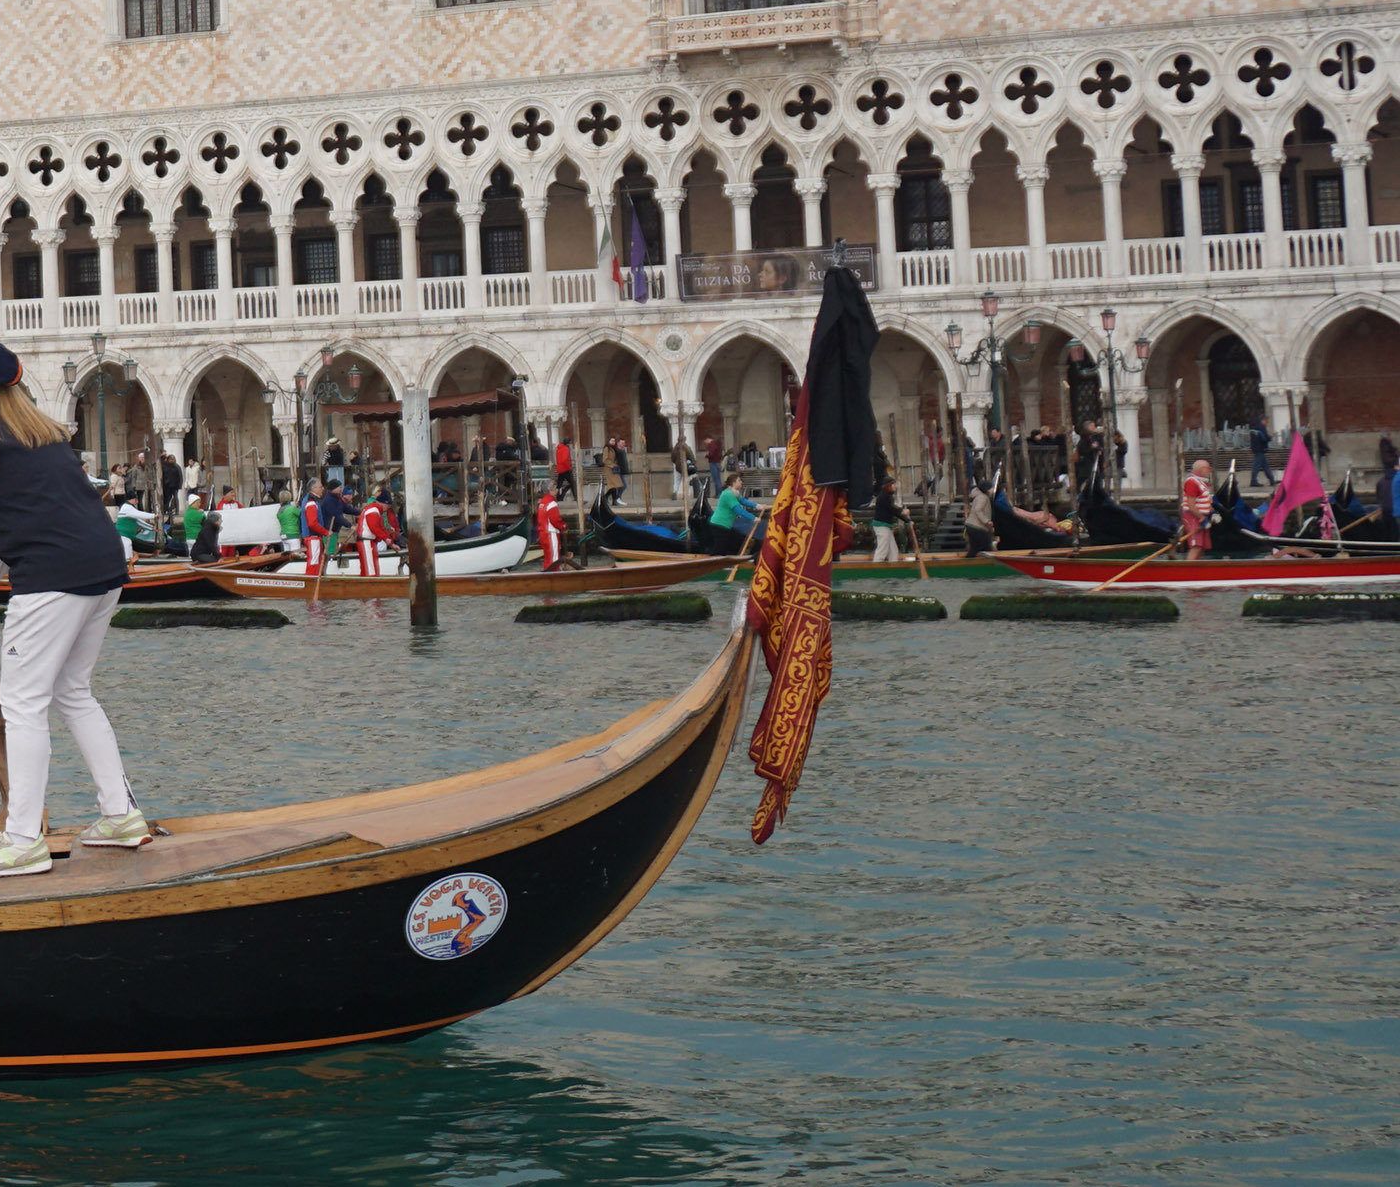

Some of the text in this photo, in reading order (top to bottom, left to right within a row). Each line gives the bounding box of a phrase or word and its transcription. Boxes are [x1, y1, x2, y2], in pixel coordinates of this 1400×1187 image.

[733, 265, 751, 274] DA
[809, 261, 816, 270] A
[695, 274, 751, 286] TIZIANO
[420, 878, 463, 907] VOGA
[468, 878, 503, 916] VENETA
[415, 930, 454, 945] MESTRE
